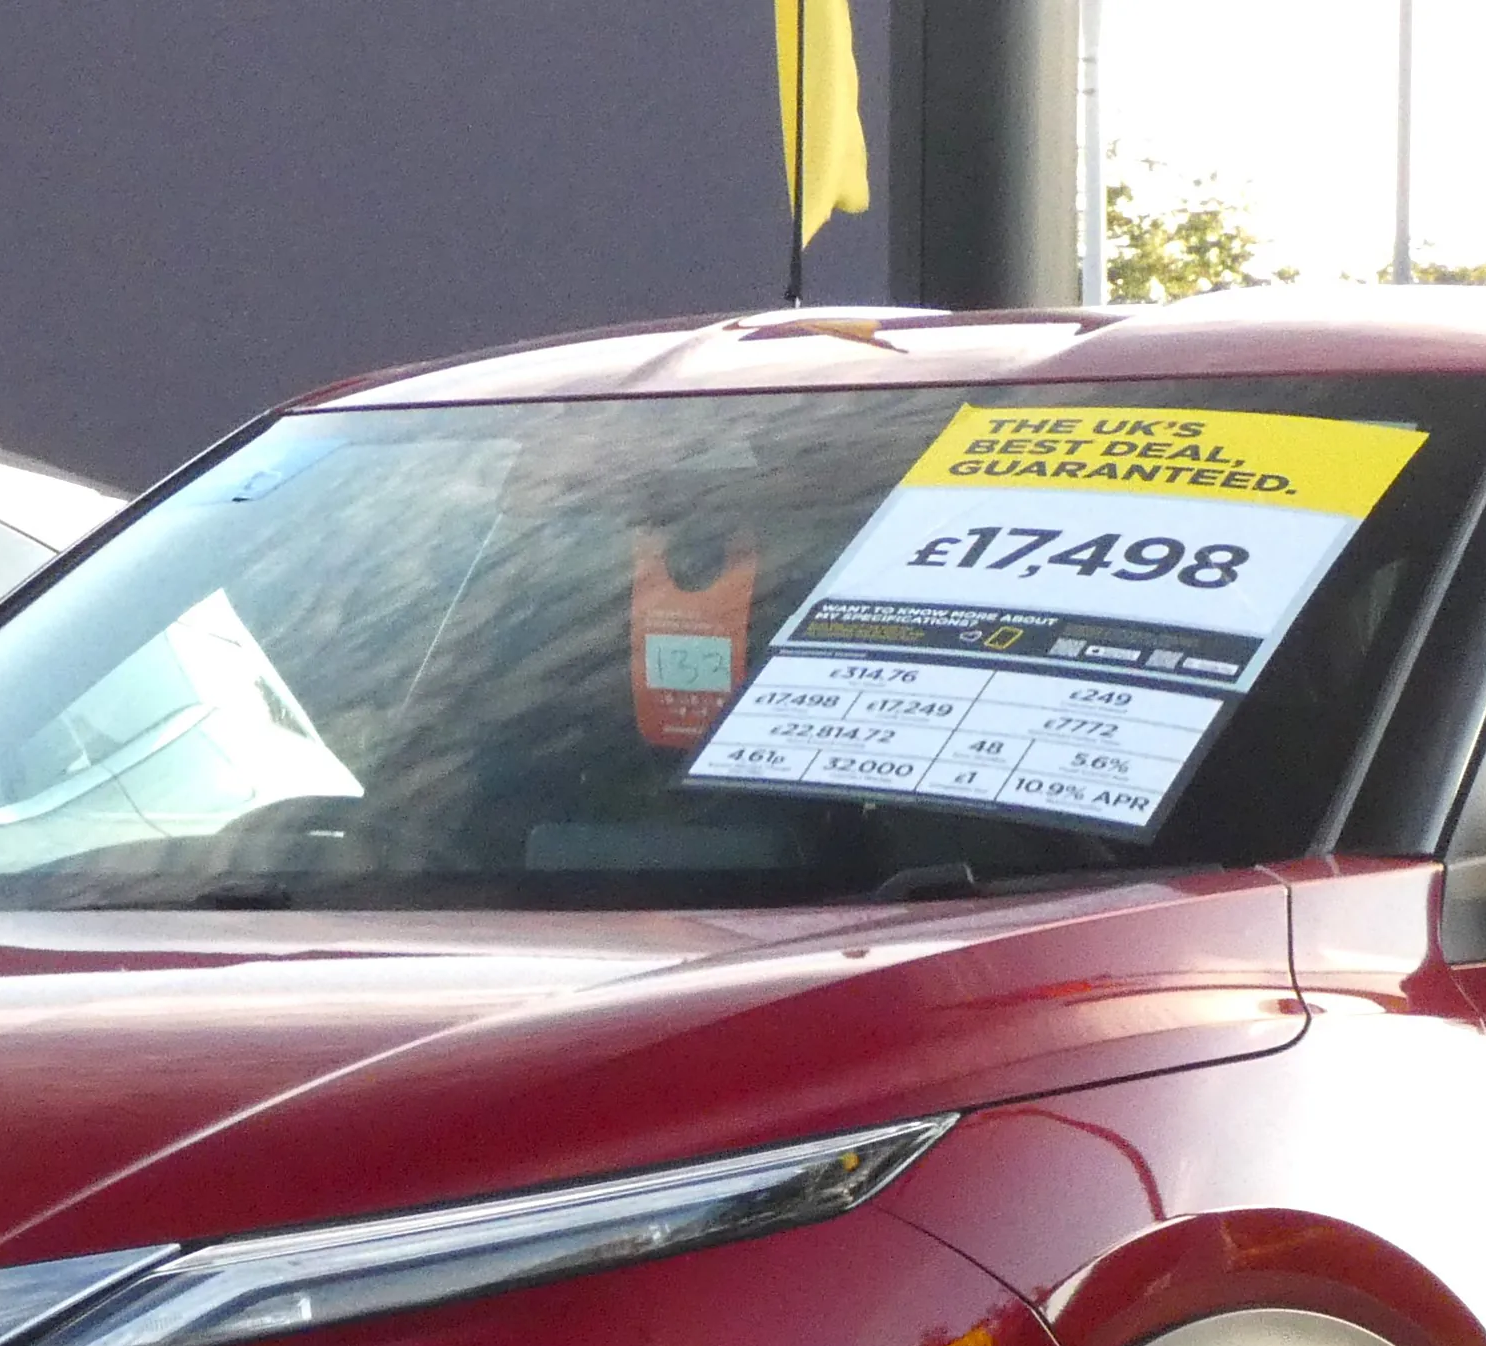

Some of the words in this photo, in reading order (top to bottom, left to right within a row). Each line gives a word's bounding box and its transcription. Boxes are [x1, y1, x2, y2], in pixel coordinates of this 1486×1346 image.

[988, 418, 1083, 435] THE
[1092, 419, 1207, 438] UK'S
[963, 438, 1093, 456] BEST
[1100, 440, 1247, 469] DEAL,
[948, 459, 1299, 496] GUARANTEED.
[906, 526, 1250, 589] £17,498
[815, 611, 840, 620] MY
[823, 603, 872, 614] WANT
[874, 606, 896, 615] TO
[897, 606, 949, 617] KNOW
[950, 609, 1000, 621] MORE
[1000, 613, 1059, 626] ABOUT
[1068, 688, 1133, 706] £249
[968, 739, 1005, 756] 48
[953, 770, 978, 785] £1
[1091, 788, 1152, 813] APR
